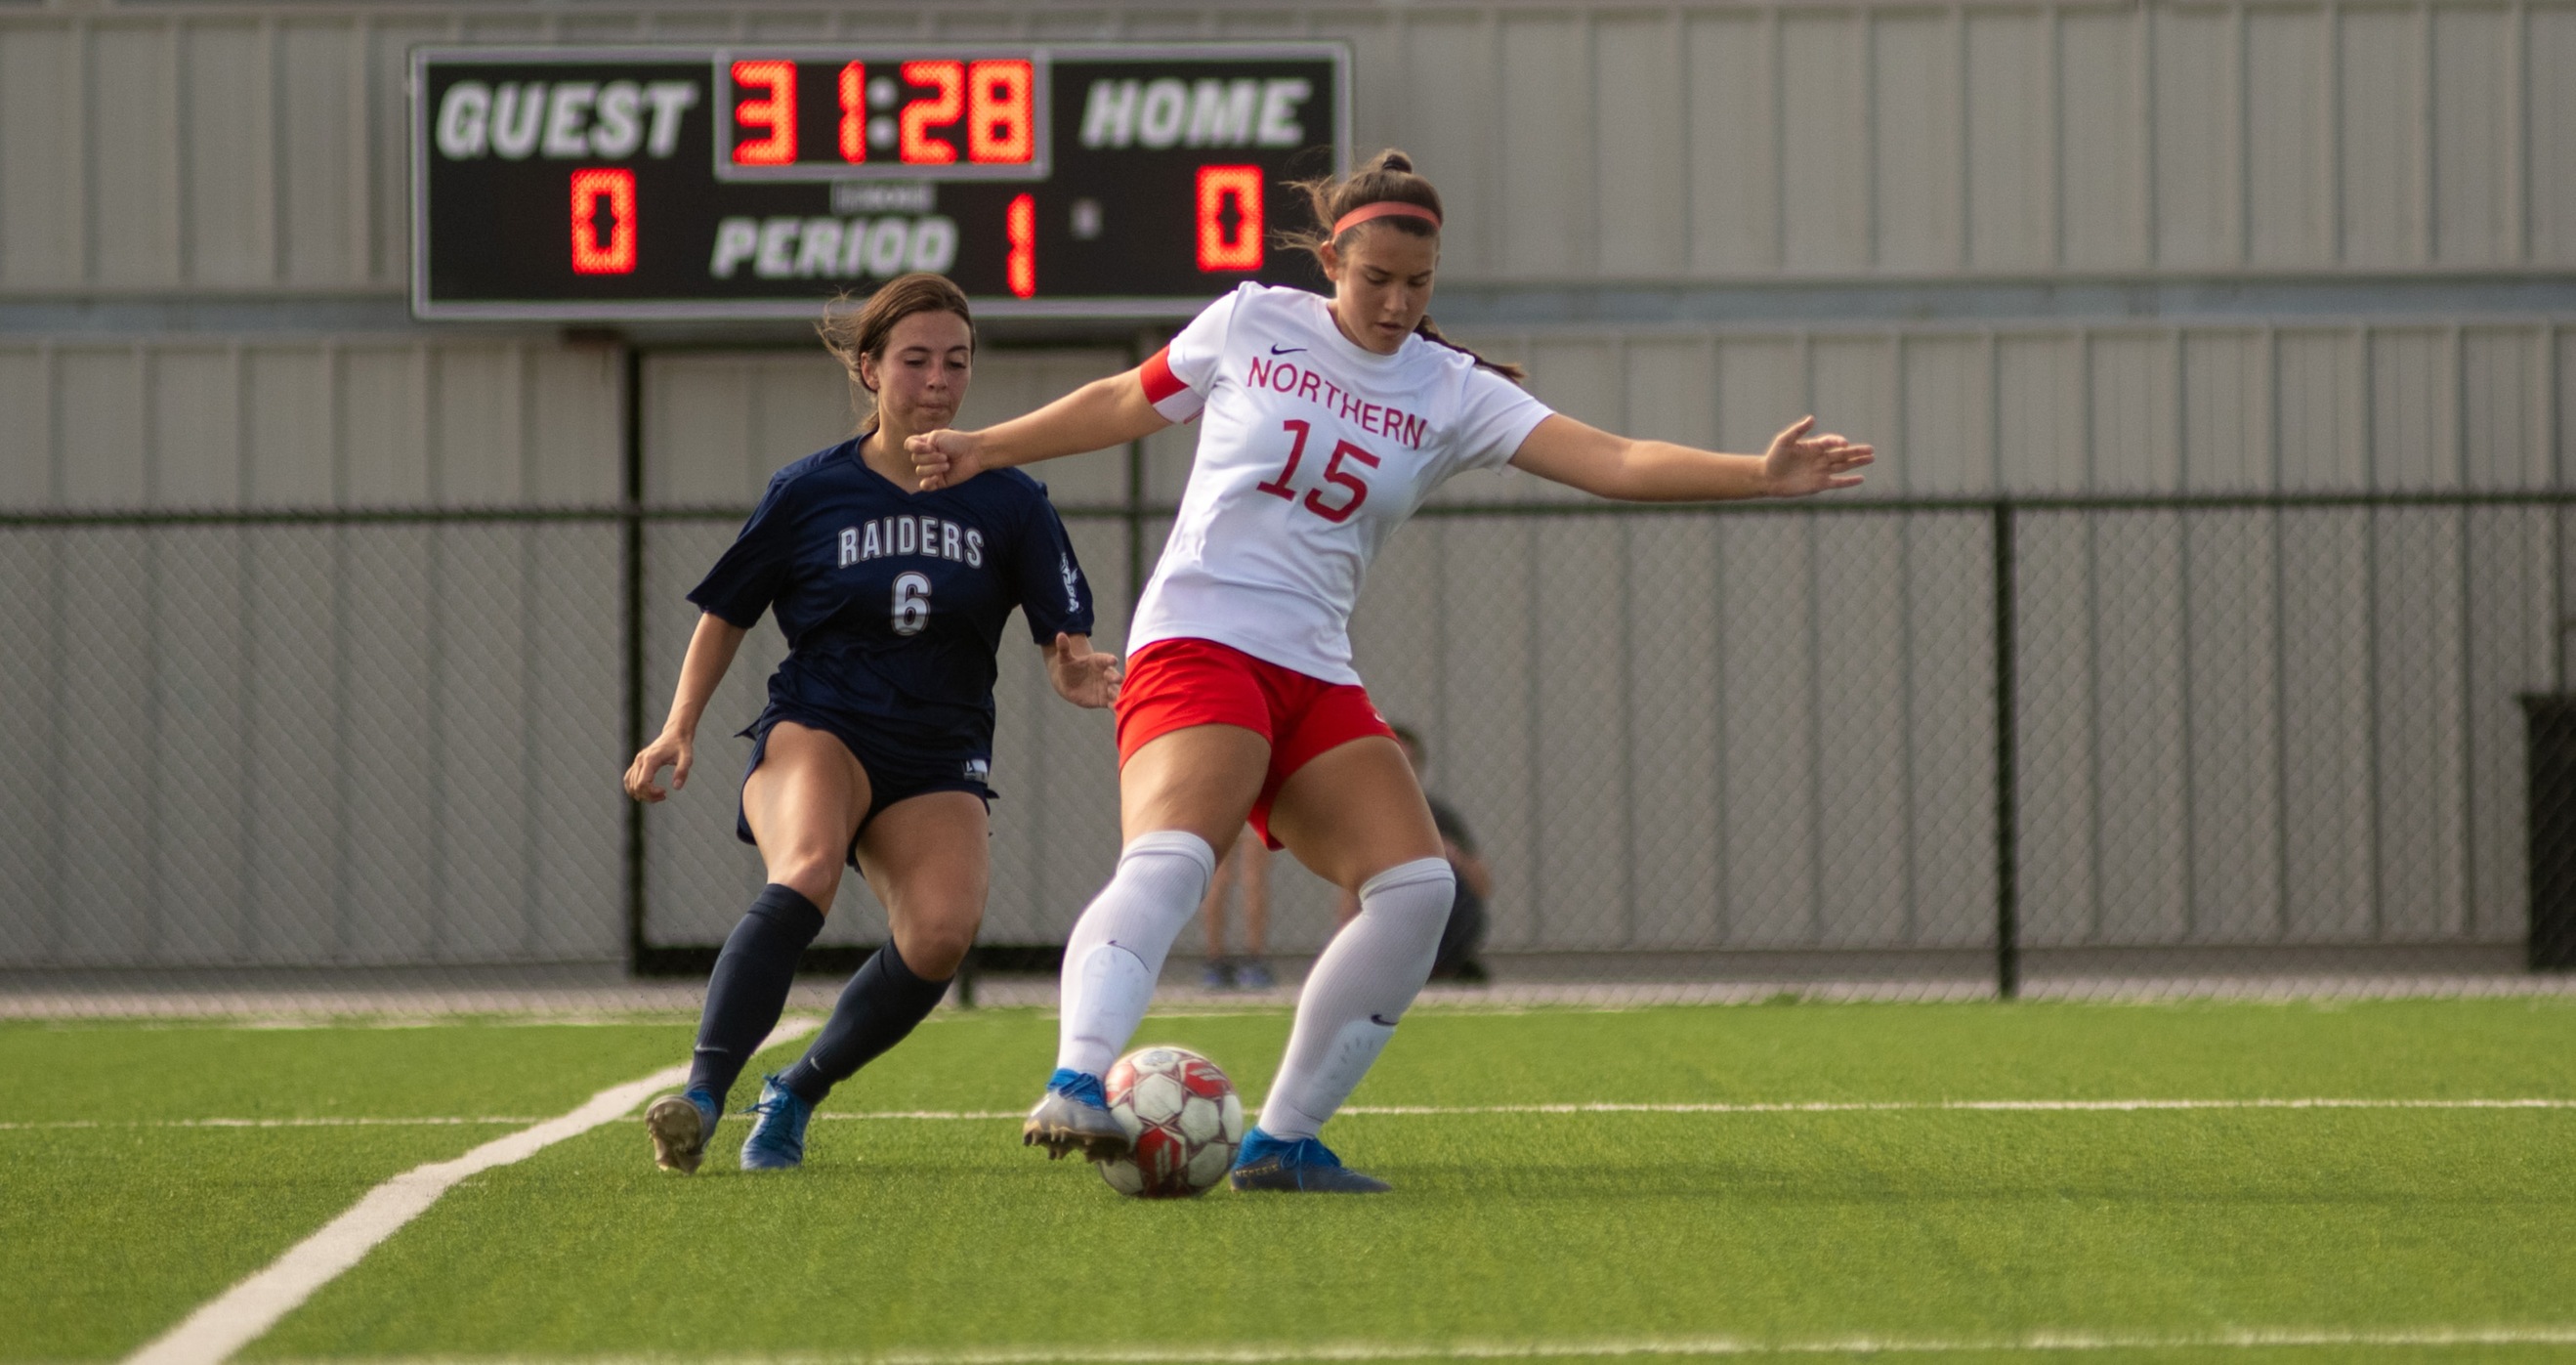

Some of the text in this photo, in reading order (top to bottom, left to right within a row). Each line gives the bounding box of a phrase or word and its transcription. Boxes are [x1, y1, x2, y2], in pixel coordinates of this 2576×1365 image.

[437, 81, 697, 160] GUEST
[732, 60, 1034, 165] 31:28
[1081, 78, 1311, 148] HOME
[571, 169, 637, 276] 0
[711, 216, 957, 277] PERIOD
[1006, 194, 1037, 300] 1
[1197, 165, 1264, 272] 0
[1247, 356, 1428, 450] NORTHERN
[1256, 419, 1381, 523] 15
[838, 515, 985, 569] RAIDERS
[891, 572, 932, 636] 6
